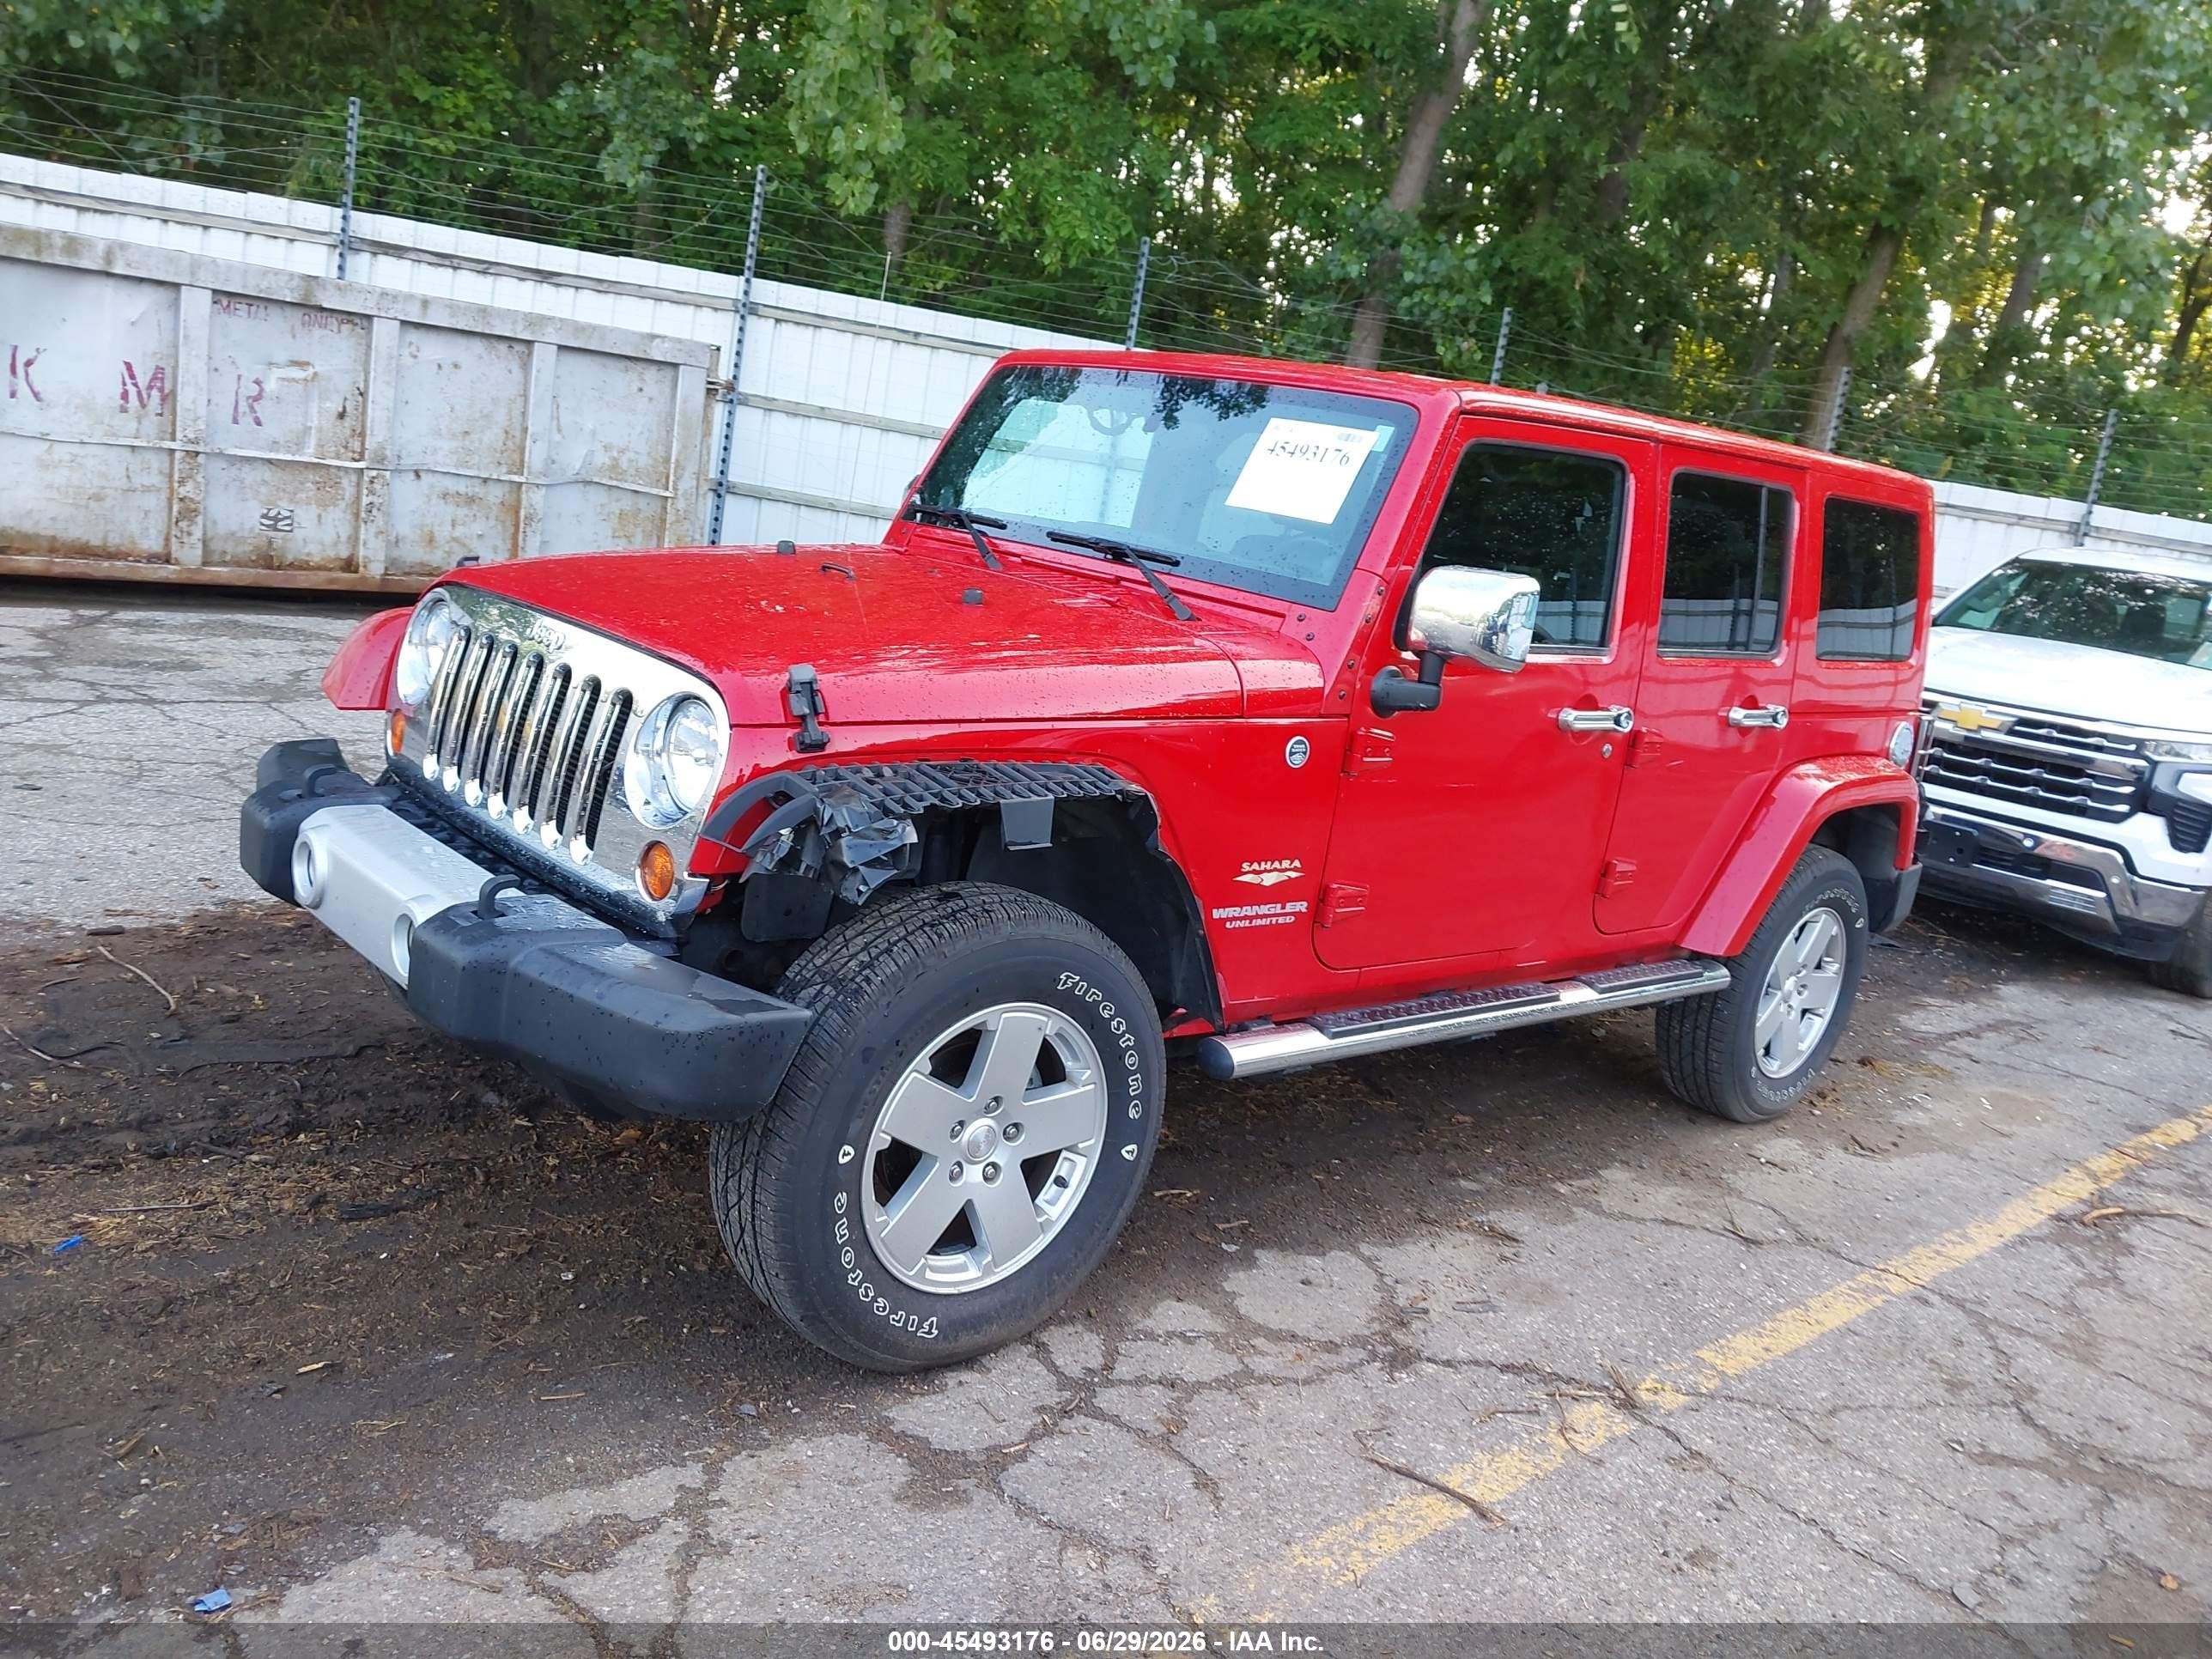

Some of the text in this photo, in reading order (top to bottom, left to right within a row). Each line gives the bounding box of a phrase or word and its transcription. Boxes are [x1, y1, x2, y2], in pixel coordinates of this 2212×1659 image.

[9, 344, 264, 427] K M R
[1267, 441, 1350, 466] 45493176
[526, 619, 567, 654] Jeep
[1241, 860, 1301, 872] SAHARA
[1212, 902, 1308, 918] WRANGLER
[1226, 916, 1295, 928] UNLIMITED
[1056, 971, 1144, 1122] Firestone
[832, 1191, 939, 1340] Firestone
